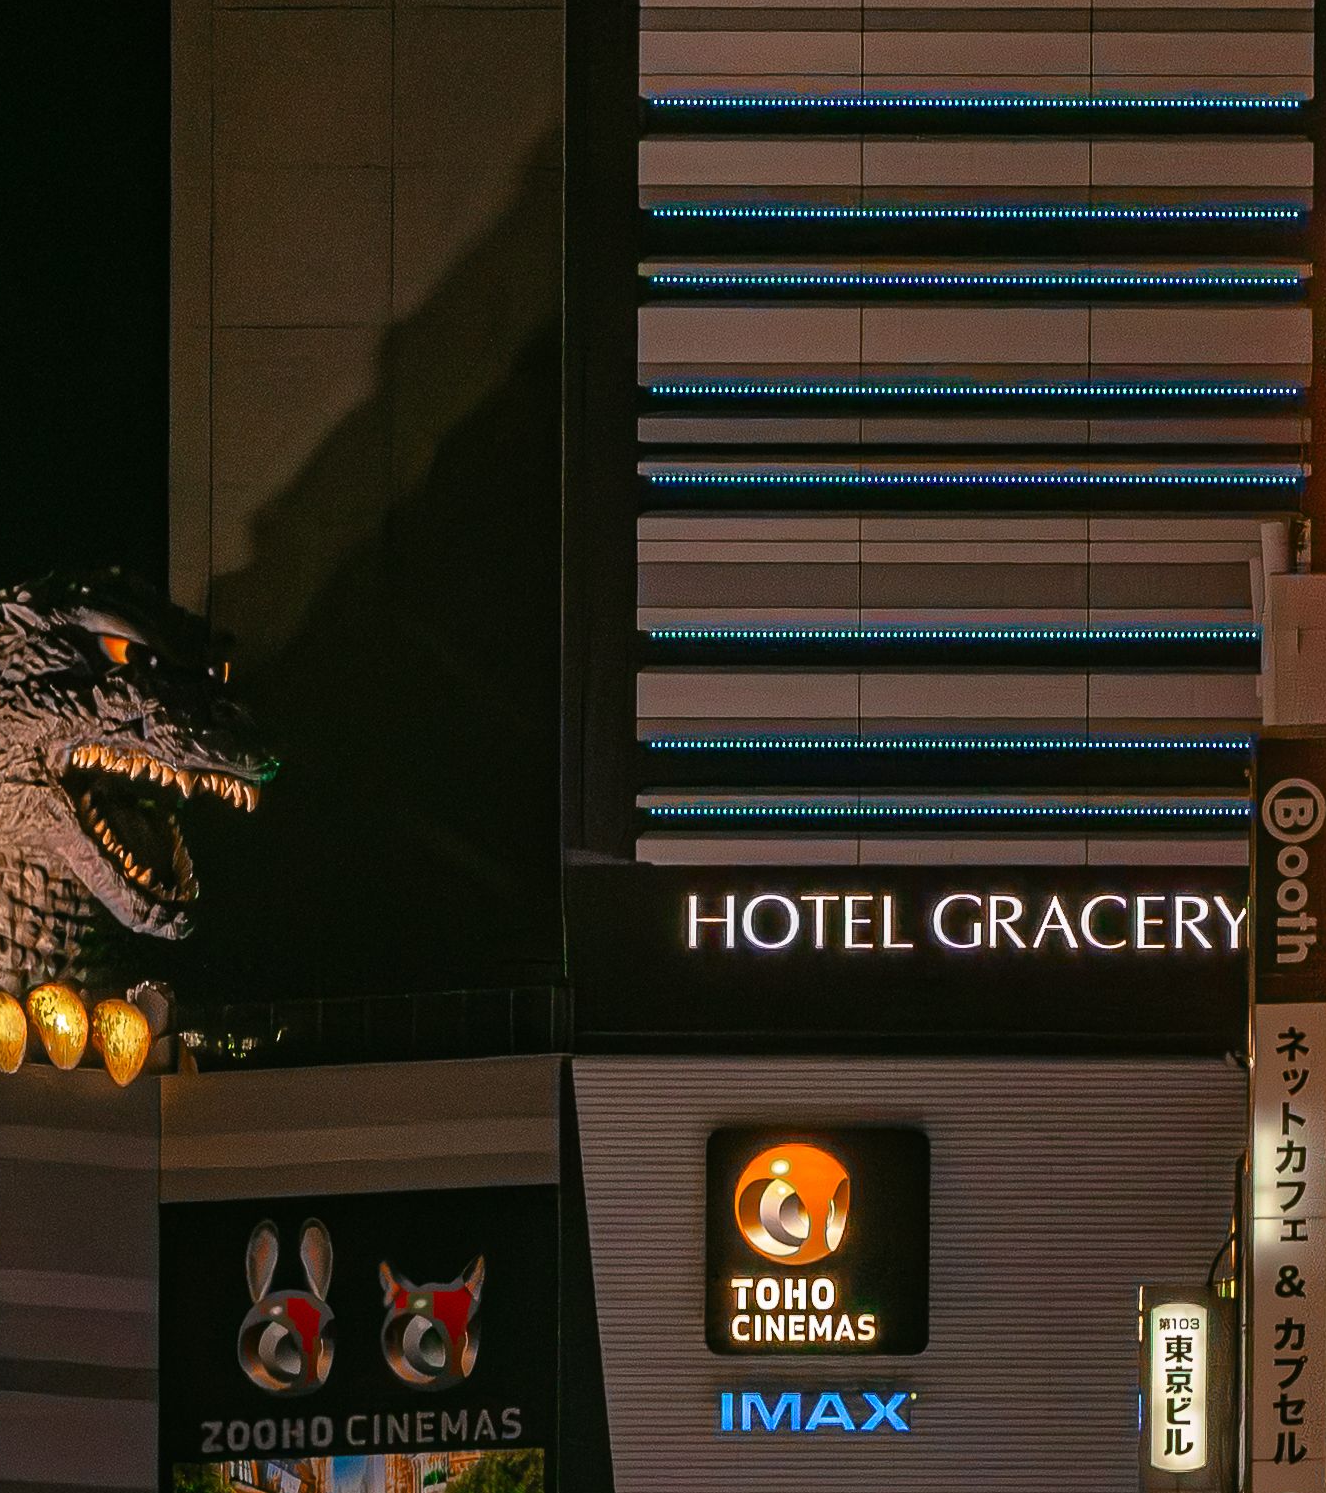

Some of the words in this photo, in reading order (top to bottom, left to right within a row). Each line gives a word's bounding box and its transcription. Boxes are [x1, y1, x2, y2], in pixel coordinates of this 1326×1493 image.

[1262, 778, 1326, 966] Booth
[687, 894, 913, 950] HOTEL
[933, 893, 1246, 951] GRACERY
[1275, 1025, 1310, 1243] ネットカフェ
[731, 1277, 836, 1311] TOHO
[1275, 1265, 1307, 1298] &
[731, 1312, 877, 1342] CINEMAS
[1160, 1316, 1200, 1331] 第103
[720, 1391, 911, 1433] IMAX
[1162, 1335, 1193, 1457] 東京ビル
[1273, 1316, 1310, 1465] カプセル
[200, 1417, 335, 1454] ZOOHO
[345, 1408, 524, 1446] CINEMAS
